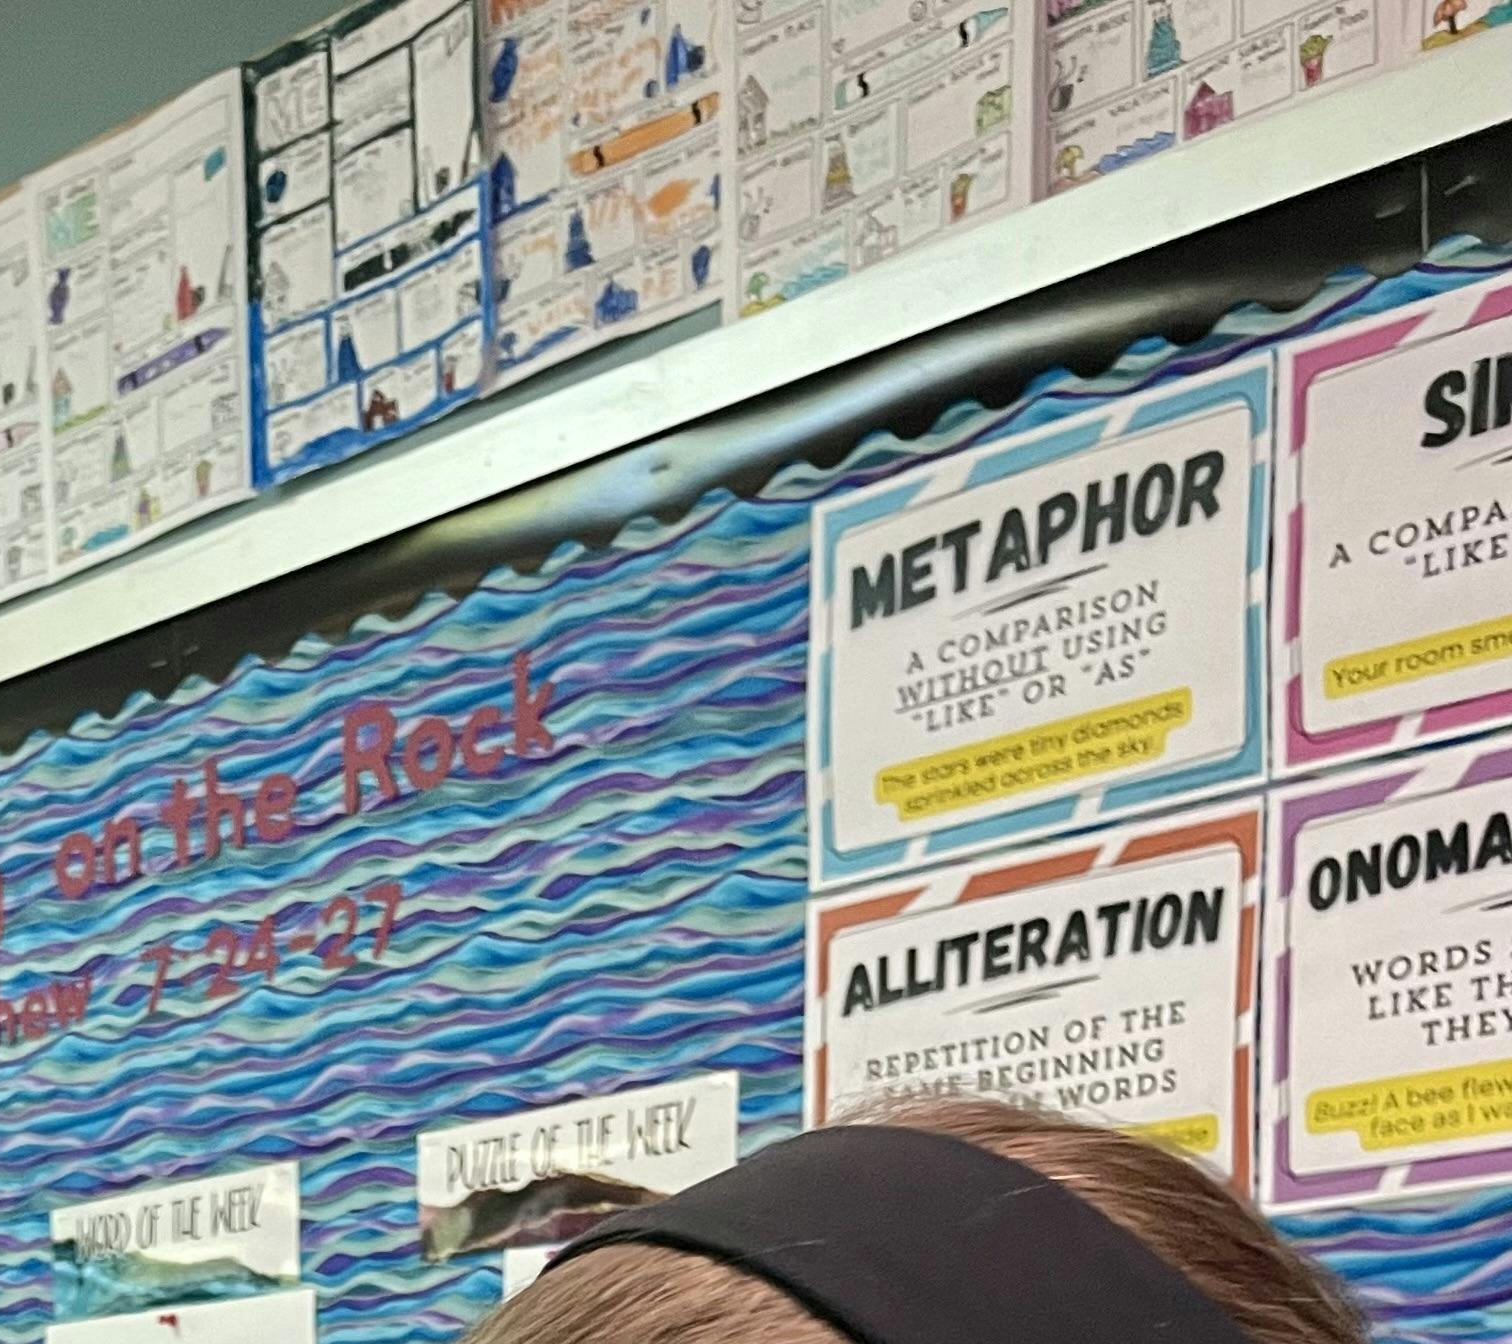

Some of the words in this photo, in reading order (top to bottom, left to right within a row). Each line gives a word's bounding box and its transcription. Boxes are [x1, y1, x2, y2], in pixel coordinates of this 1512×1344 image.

[850, 450, 1225, 630] METAPHOR
[1329, 543, 1351, 568] A
[1369, 500, 1512, 555] COMPA
[906, 652, 925, 674] A
[937, 581, 1159, 664] COMPARISON
[896, 646, 1048, 712] WITHOUT
[1062, 611, 1168, 660] USING
[1023, 673, 1067, 705] OR
[1332, 661, 1387, 688] Your
[1395, 644, 1464, 672] room
[54, 814, 142, 901] on
[160, 758, 299, 871] the
[343, 649, 559, 817] Rock
[841, 887, 1225, 1017] ALLITERATION
[1352, 940, 1491, 987] WORDS
[1369, 983, 1452, 1019] LIKE
[865, 1026, 1049, 1081] REPETITION
[1065, 1016, 1107, 1043] OF
[1119, 1001, 1187, 1034] THE
[976, 1039, 1165, 1092] BEGINNING
[1057, 1069, 1178, 1111] WORDS
[1383, 1092, 1399, 1109] A
[1406, 1089, 1454, 1107] bee
[531, 1124, 562, 1177] OF
[575, 1114, 616, 1168] THE
[627, 1097, 697, 1160] WEEK
[1370, 1116, 1424, 1137] face
[1433, 1110, 1460, 1128] as
[136, 1204, 163, 1249] OF
[171, 1196, 203, 1243] THE
[210, 1183, 265, 1237] WEEK
